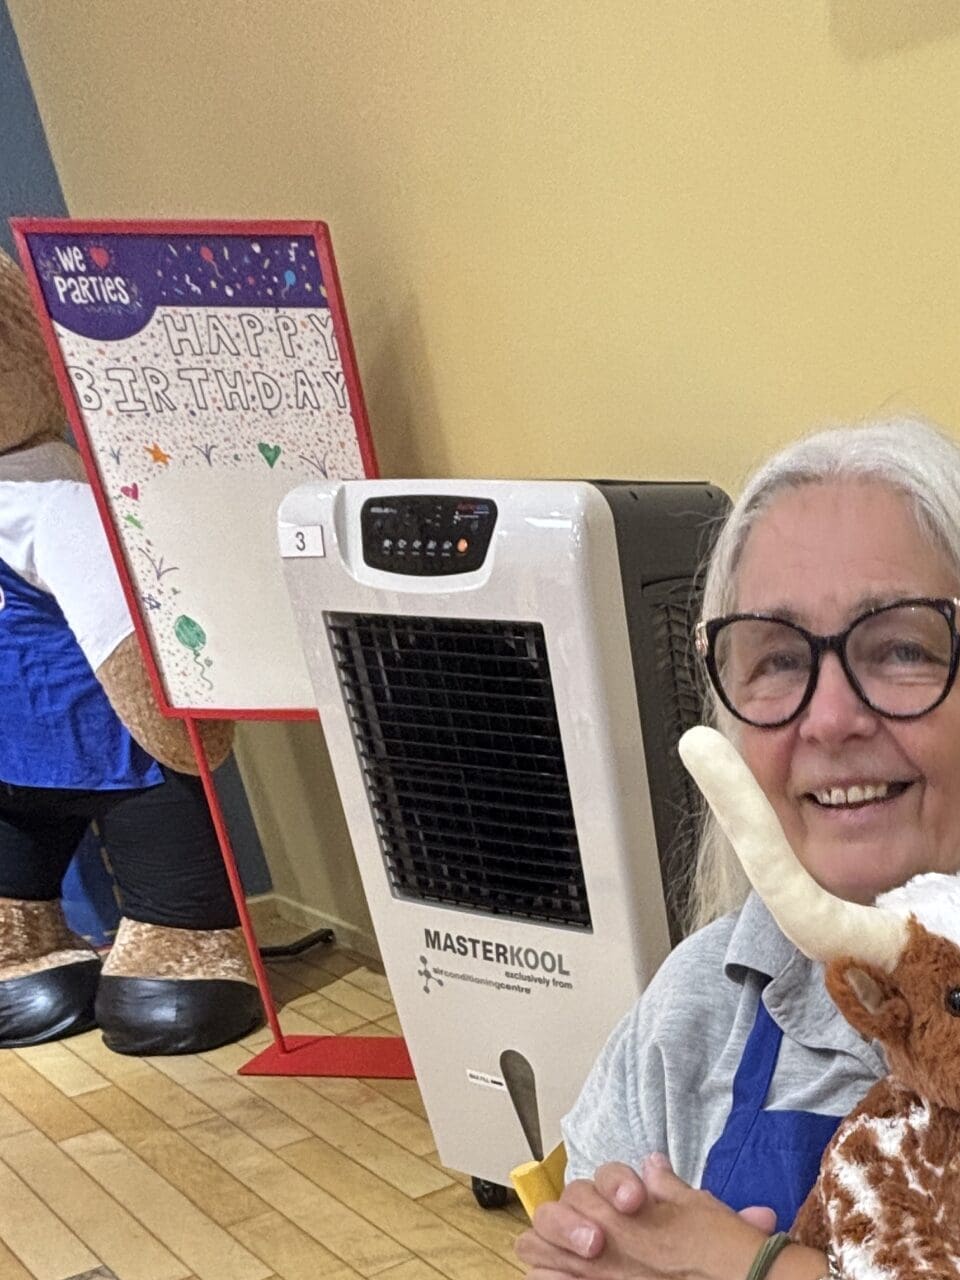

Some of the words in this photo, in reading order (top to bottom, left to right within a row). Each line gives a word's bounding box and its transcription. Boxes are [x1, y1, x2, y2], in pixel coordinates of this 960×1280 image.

[163, 313, 338, 361] HAPPY
[67, 365, 347, 412] BIRTHDAY
[295, 531, 306, 551] 3
[424, 928, 570, 976] MASTERKOOL
[504, 971, 551, 987] exclusively
[552, 977, 573, 989] from
